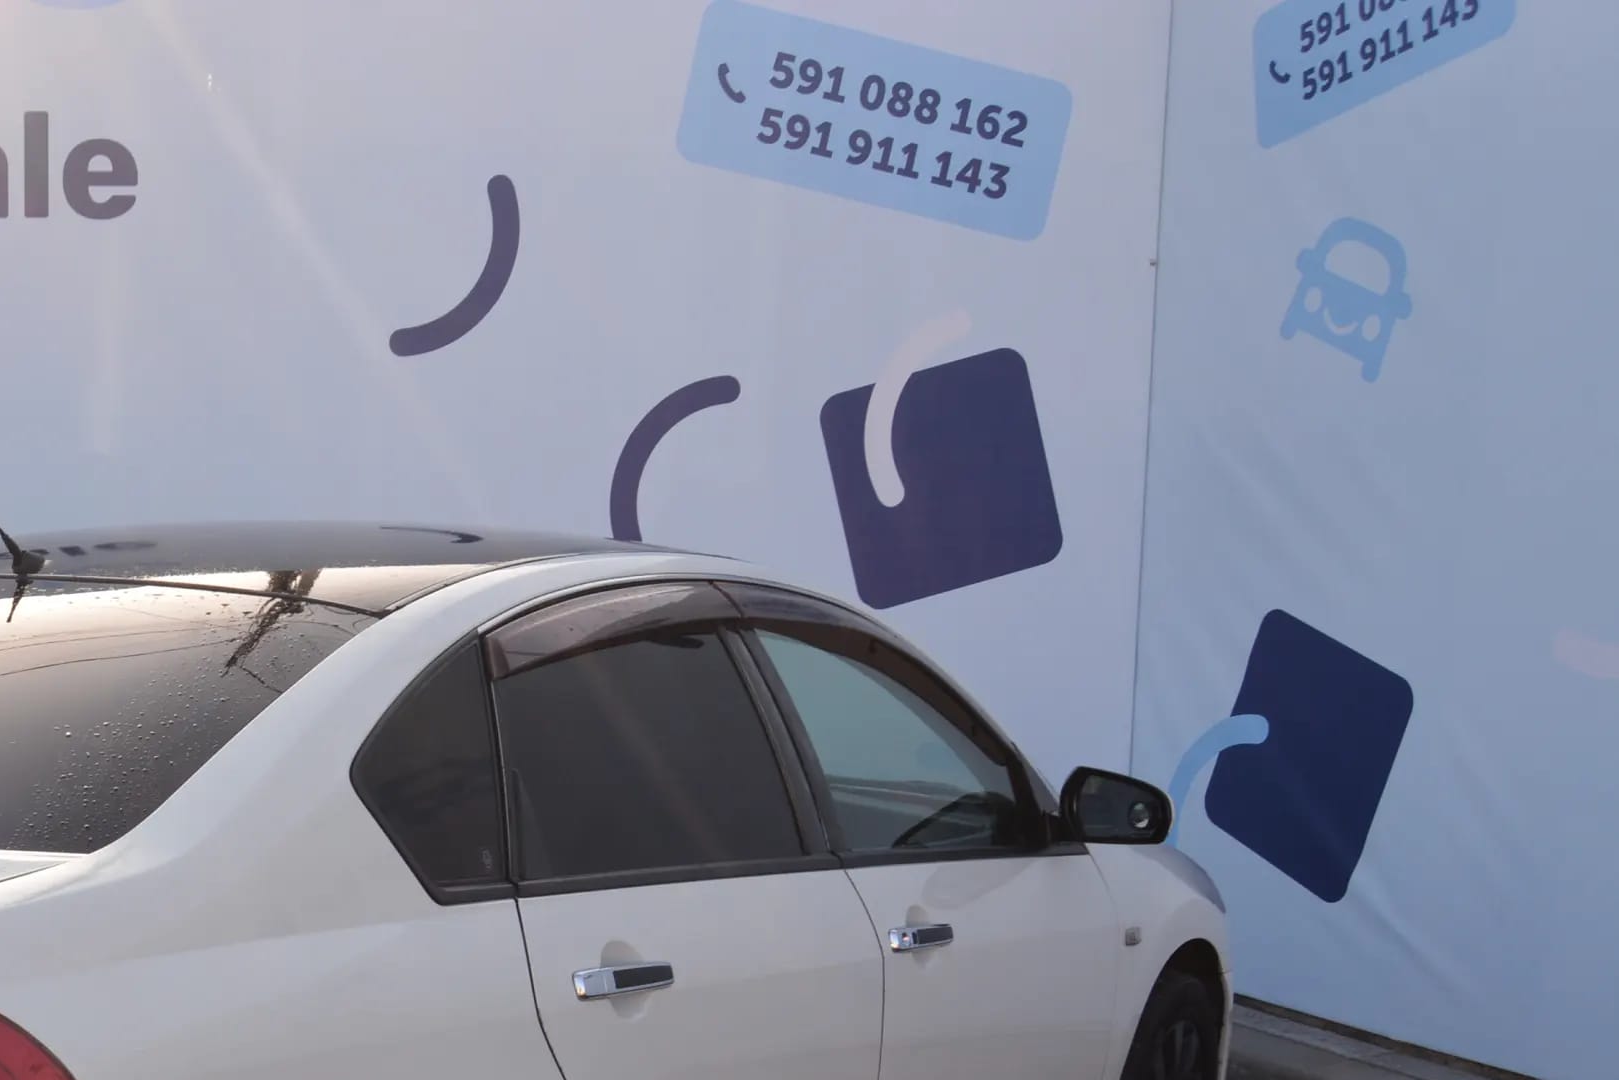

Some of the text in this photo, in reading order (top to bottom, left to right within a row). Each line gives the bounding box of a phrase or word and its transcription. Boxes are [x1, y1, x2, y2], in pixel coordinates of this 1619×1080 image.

[1299, 2, 1351, 53] 591
[1302, 50, 1353, 100] 591
[1359, 19, 1414, 72] 911
[769, 51, 1029, 148] 591 088 162
[756, 107, 1011, 200] 591 911 143
